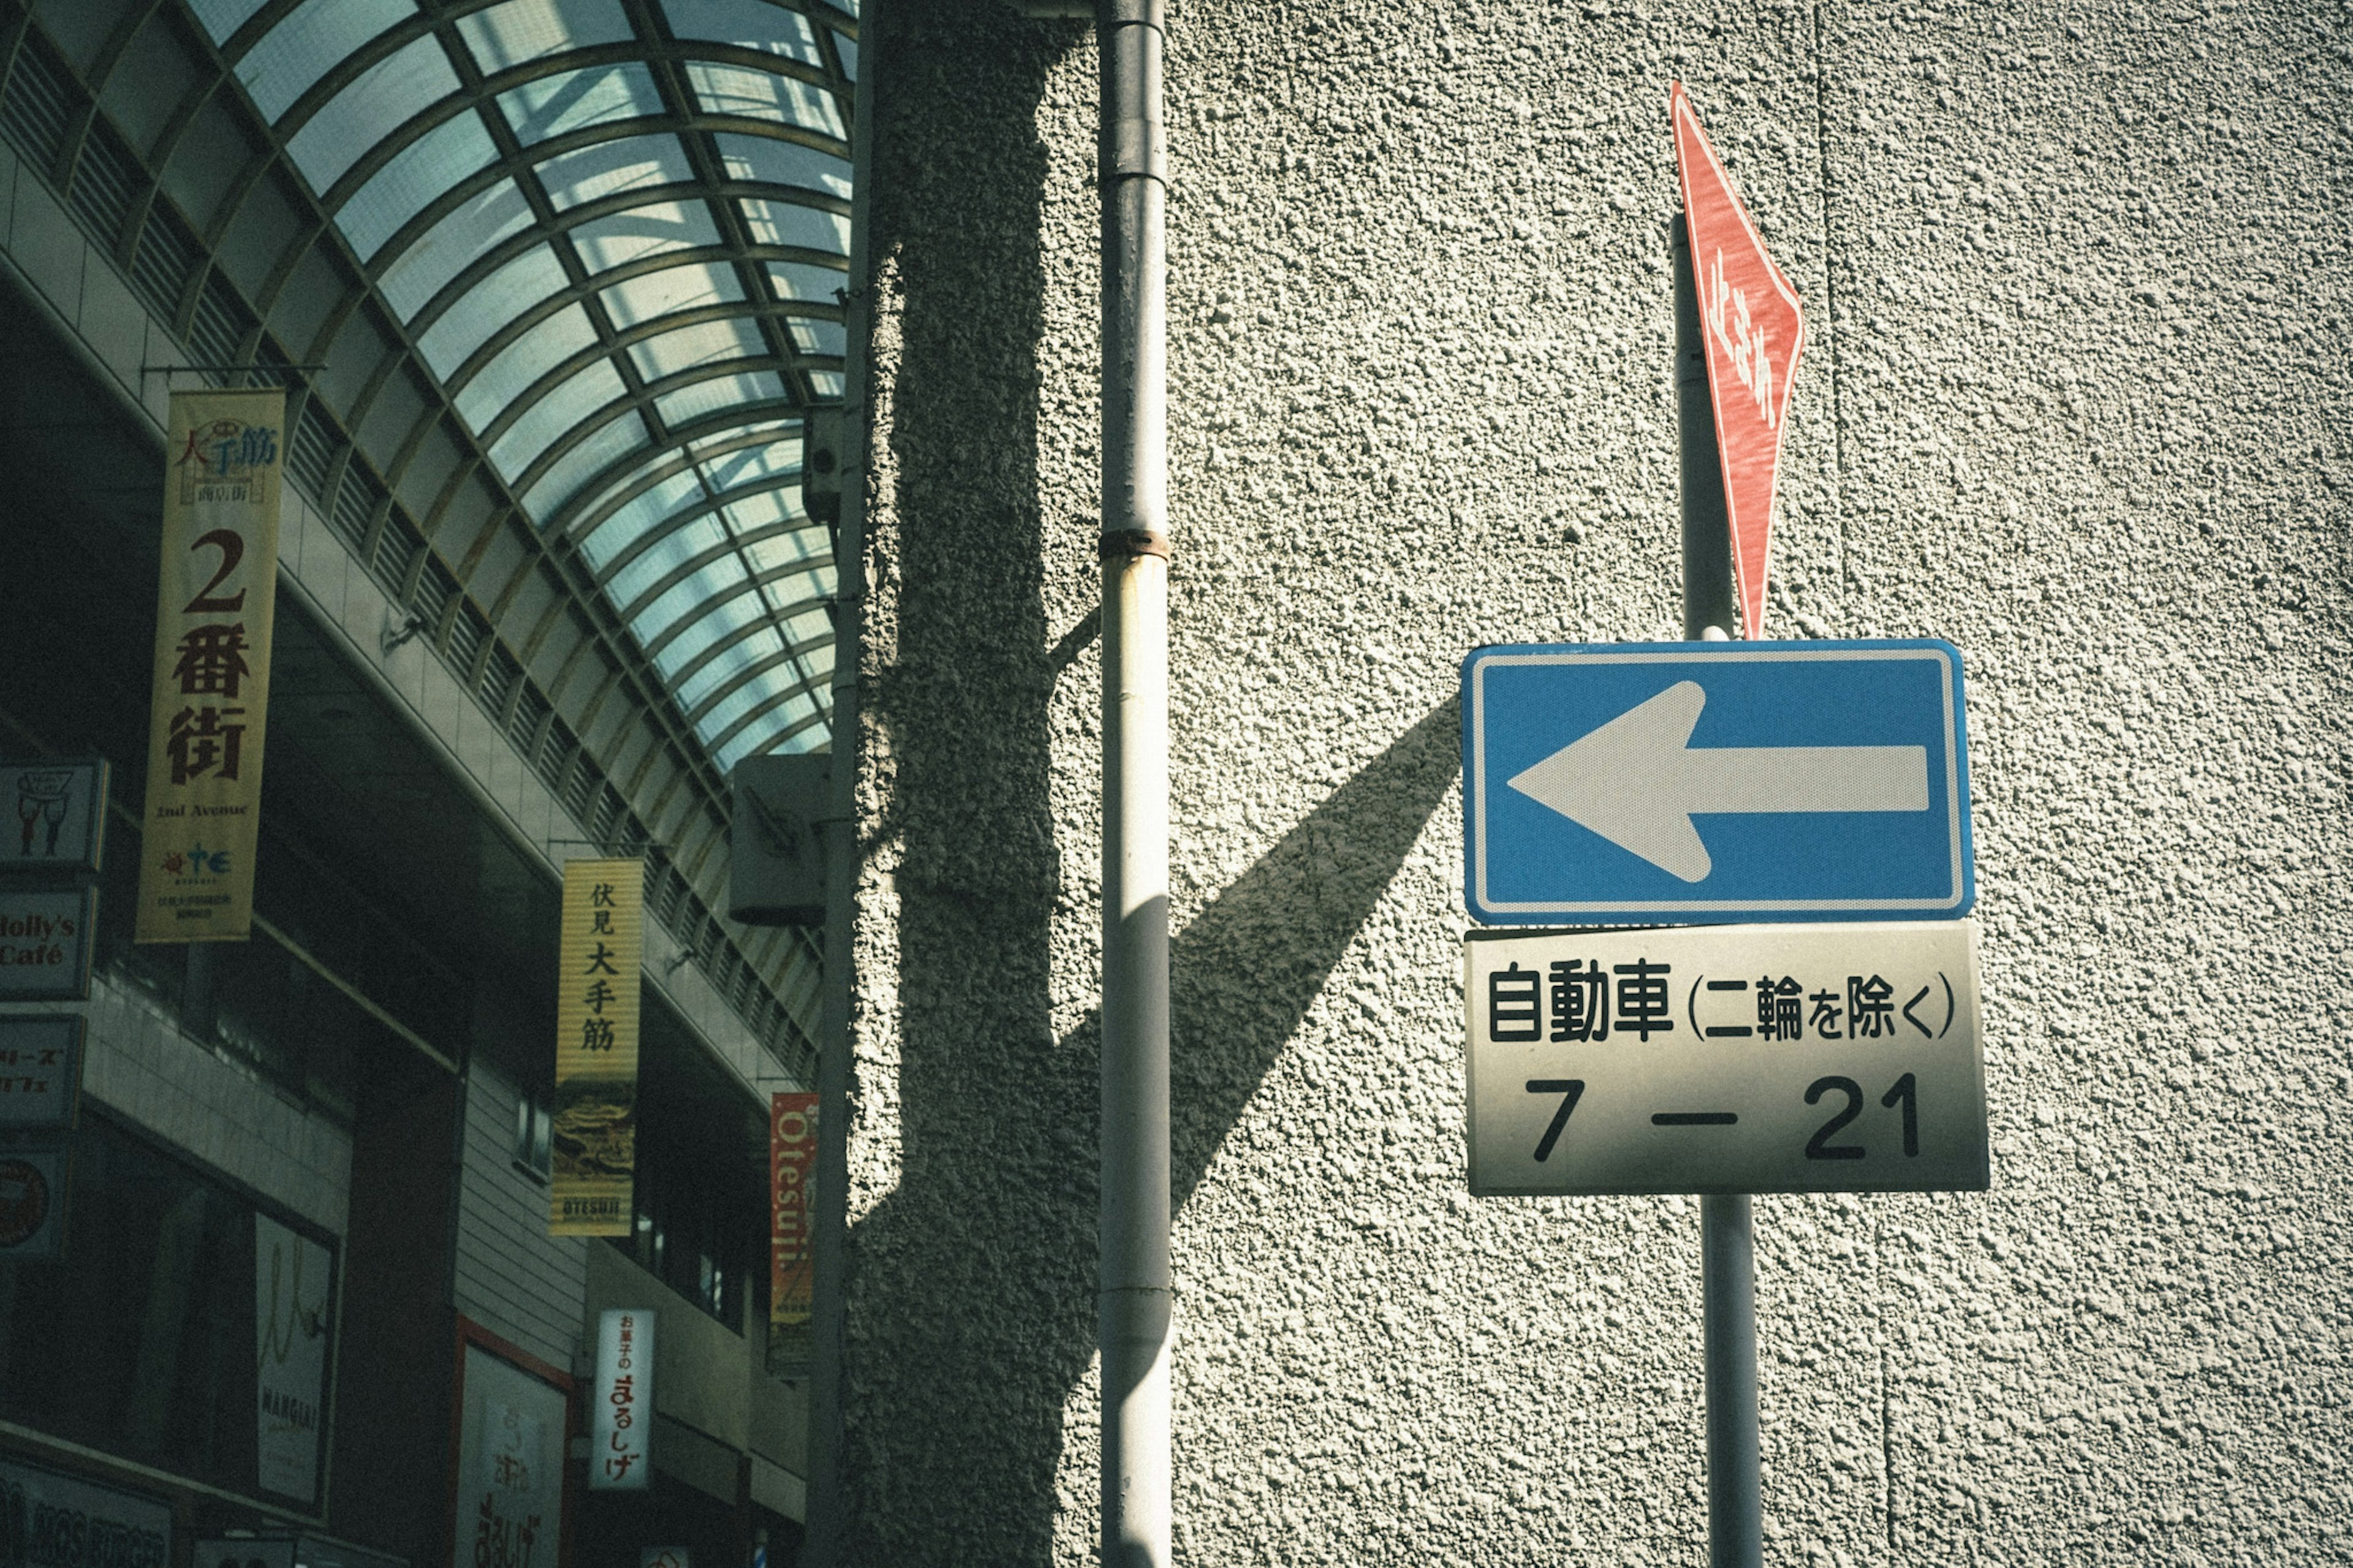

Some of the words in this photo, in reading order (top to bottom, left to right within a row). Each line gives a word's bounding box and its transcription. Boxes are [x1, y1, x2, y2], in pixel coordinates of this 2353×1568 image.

[1709, 246, 1776, 430] 止まれ
[157, 804, 185, 818] 2nd
[192, 805, 248, 817] Avenue
[1525, 1079, 1585, 1162] 7
[1804, 1072, 1920, 1161] 21
[771, 1110, 809, 1261] Otesuji
